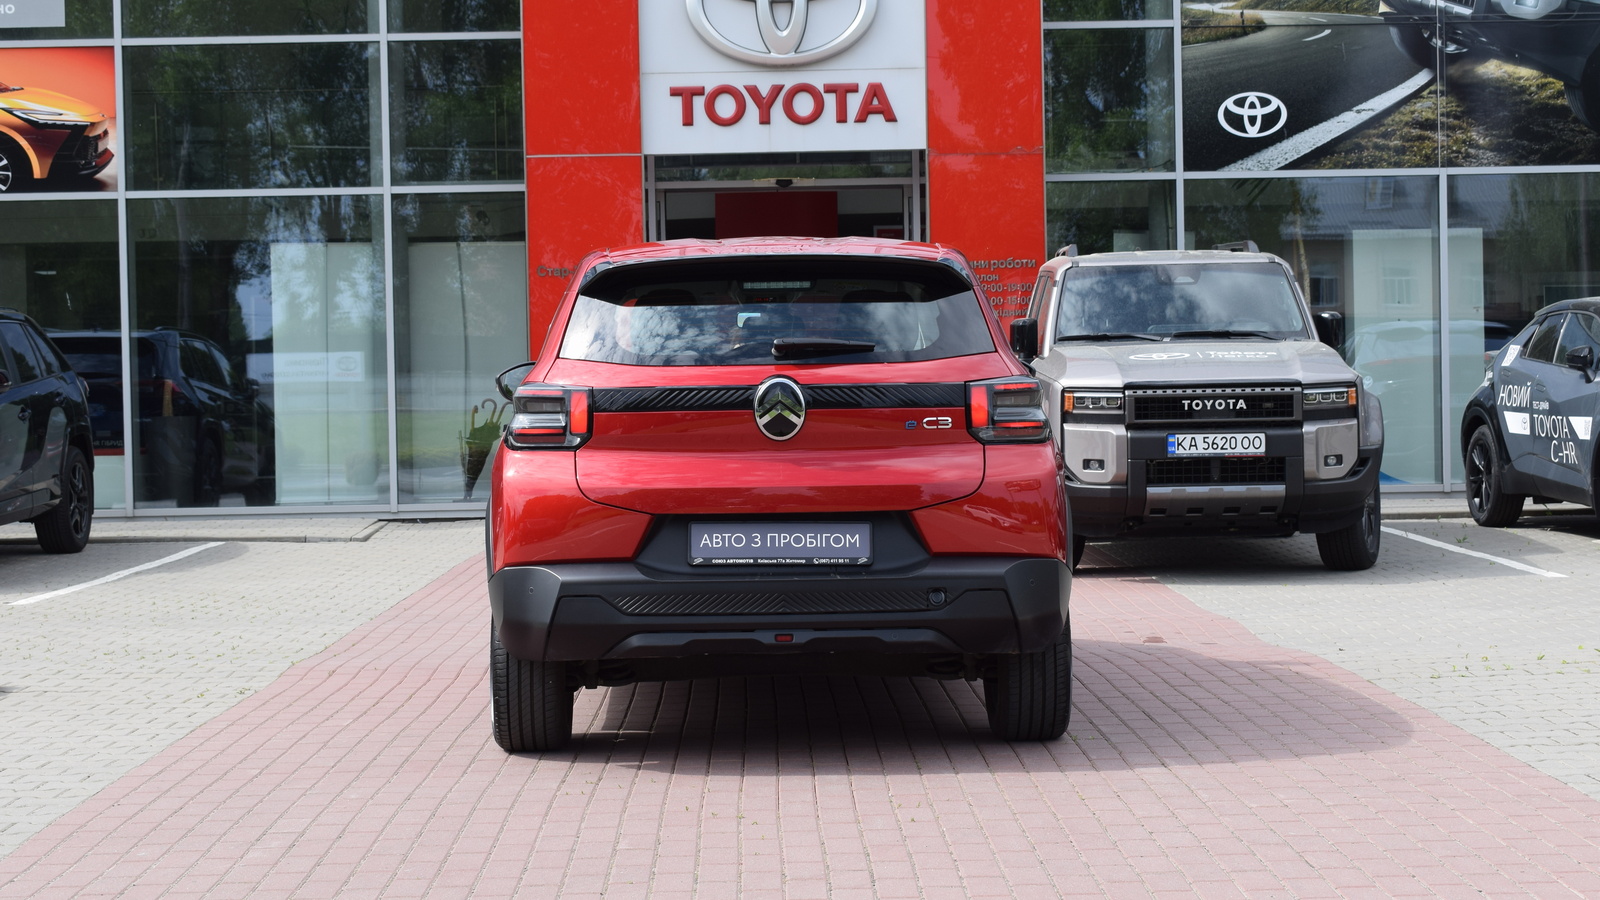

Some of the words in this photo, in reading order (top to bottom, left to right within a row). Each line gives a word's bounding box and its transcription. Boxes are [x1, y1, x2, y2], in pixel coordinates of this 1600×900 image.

[669, 82, 898, 127] TOYOTA
[990, 257, 1036, 271] роботи
[1497, 381, 1532, 408] НОВИЙ
[1182, 399, 1247, 411] TOYOTA
[922, 416, 952, 429] C3
[1533, 414, 1571, 439] TOYOTA
[1176, 436, 1199, 451] KA
[1202, 436, 1238, 451] 5620
[1240, 435, 1263, 450] OO
[1551, 440, 1578, 465] C-HR
[699, 533, 746, 548] АВТО
[751, 533, 762, 548] З
[767, 533, 860, 548] ПРОБІГОМ
